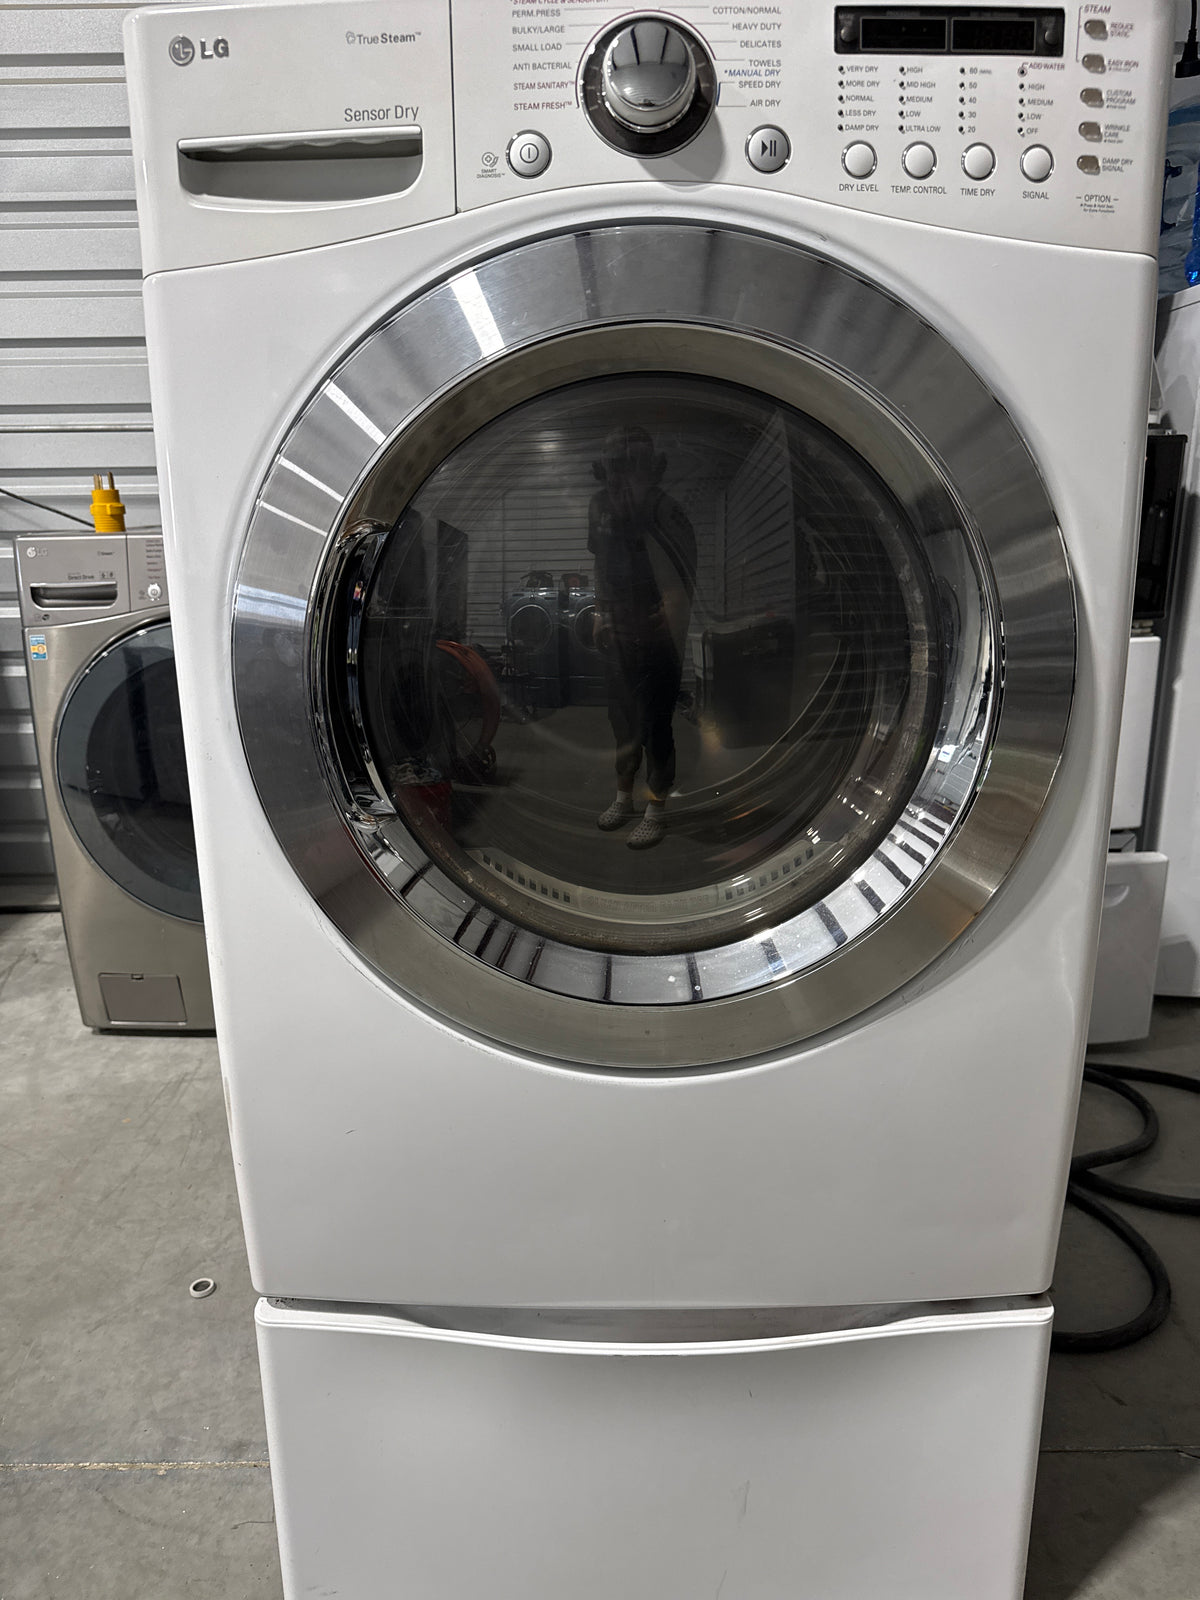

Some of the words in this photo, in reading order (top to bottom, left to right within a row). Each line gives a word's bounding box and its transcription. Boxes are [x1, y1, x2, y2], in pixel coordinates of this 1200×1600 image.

[512, 10, 560, 18] PERM.PRESS
[712, 6, 781, 14] COTTON/NORMAL
[1084, 6, 1111, 14] STEAM
[512, 26, 565, 34] BULKY/LARGE
[512, 44, 538, 52] SMALL
[541, 43, 562, 51] LOAD
[740, 40, 781, 48] DELICATES
[200, 37, 230, 60] LG
[513, 63, 530, 71] ANTI
[532, 62, 572, 70] BACTERIAL
[514, 82, 536, 90] STEAM
[514, 103, 540, 111] STEAM
[344, 107, 391, 122] Sensor
[394, 105, 419, 122] Dry
[839, 184, 855, 192] DRY
[857, 184, 879, 192] LEVEL
[891, 185, 911, 194] TEMP.
[913, 185, 947, 194] CONTROL
[960, 188, 979, 196] TIME
[980, 188, 995, 197] DRY
[1022, 191, 1049, 200] SIGNAL
[1084, 194, 1111, 202] OPTION
